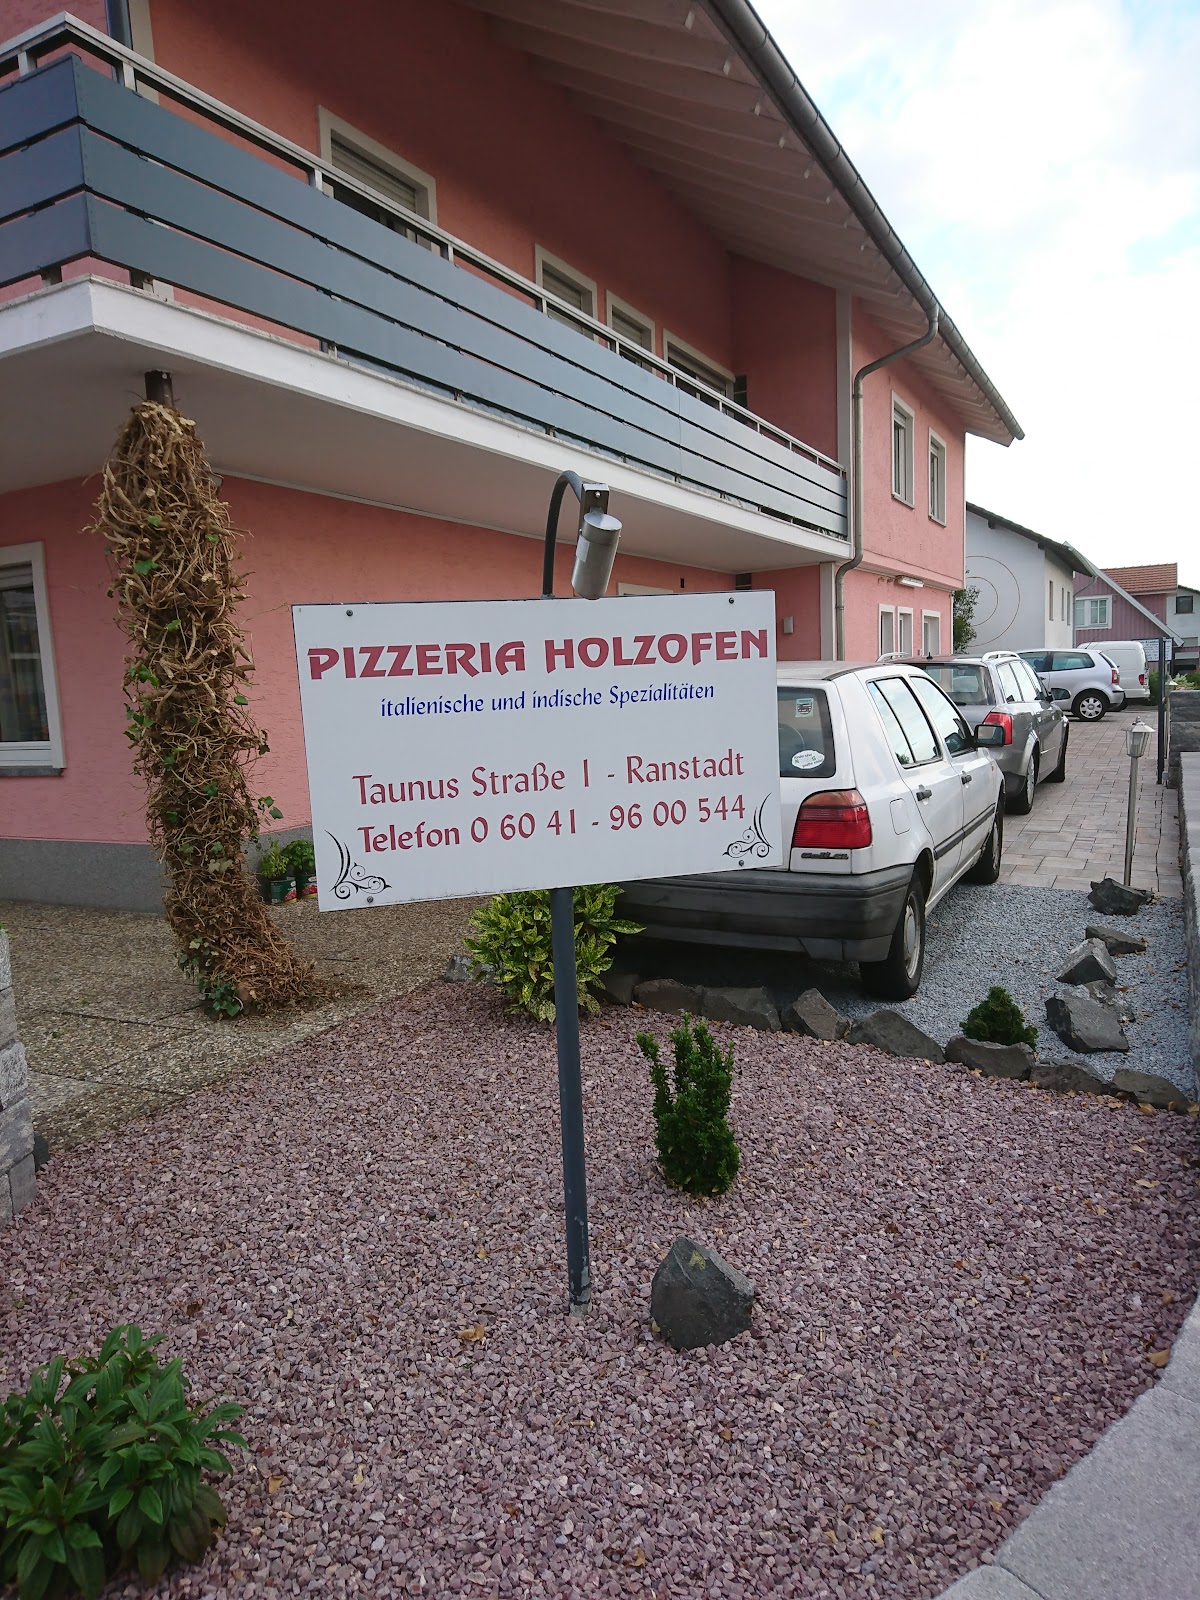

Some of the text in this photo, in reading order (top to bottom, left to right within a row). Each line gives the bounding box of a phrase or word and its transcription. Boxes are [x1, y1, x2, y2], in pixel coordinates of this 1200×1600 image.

[307, 630, 768, 680] PIZZERIA HOLZOFEN
[380, 682, 715, 717] italienische und indische Spezialitäten
[352, 774, 459, 805] Taunus
[471, 762, 566, 796] Straße
[626, 748, 745, 784] Ranstadt
[358, 821, 460, 853] Telefon
[470, 815, 488, 844] 0
[499, 813, 536, 841] 60
[546, 808, 577, 836] 41
[609, 803, 643, 831] 96
[652, 799, 687, 828] 00
[697, 794, 746, 824] 544
